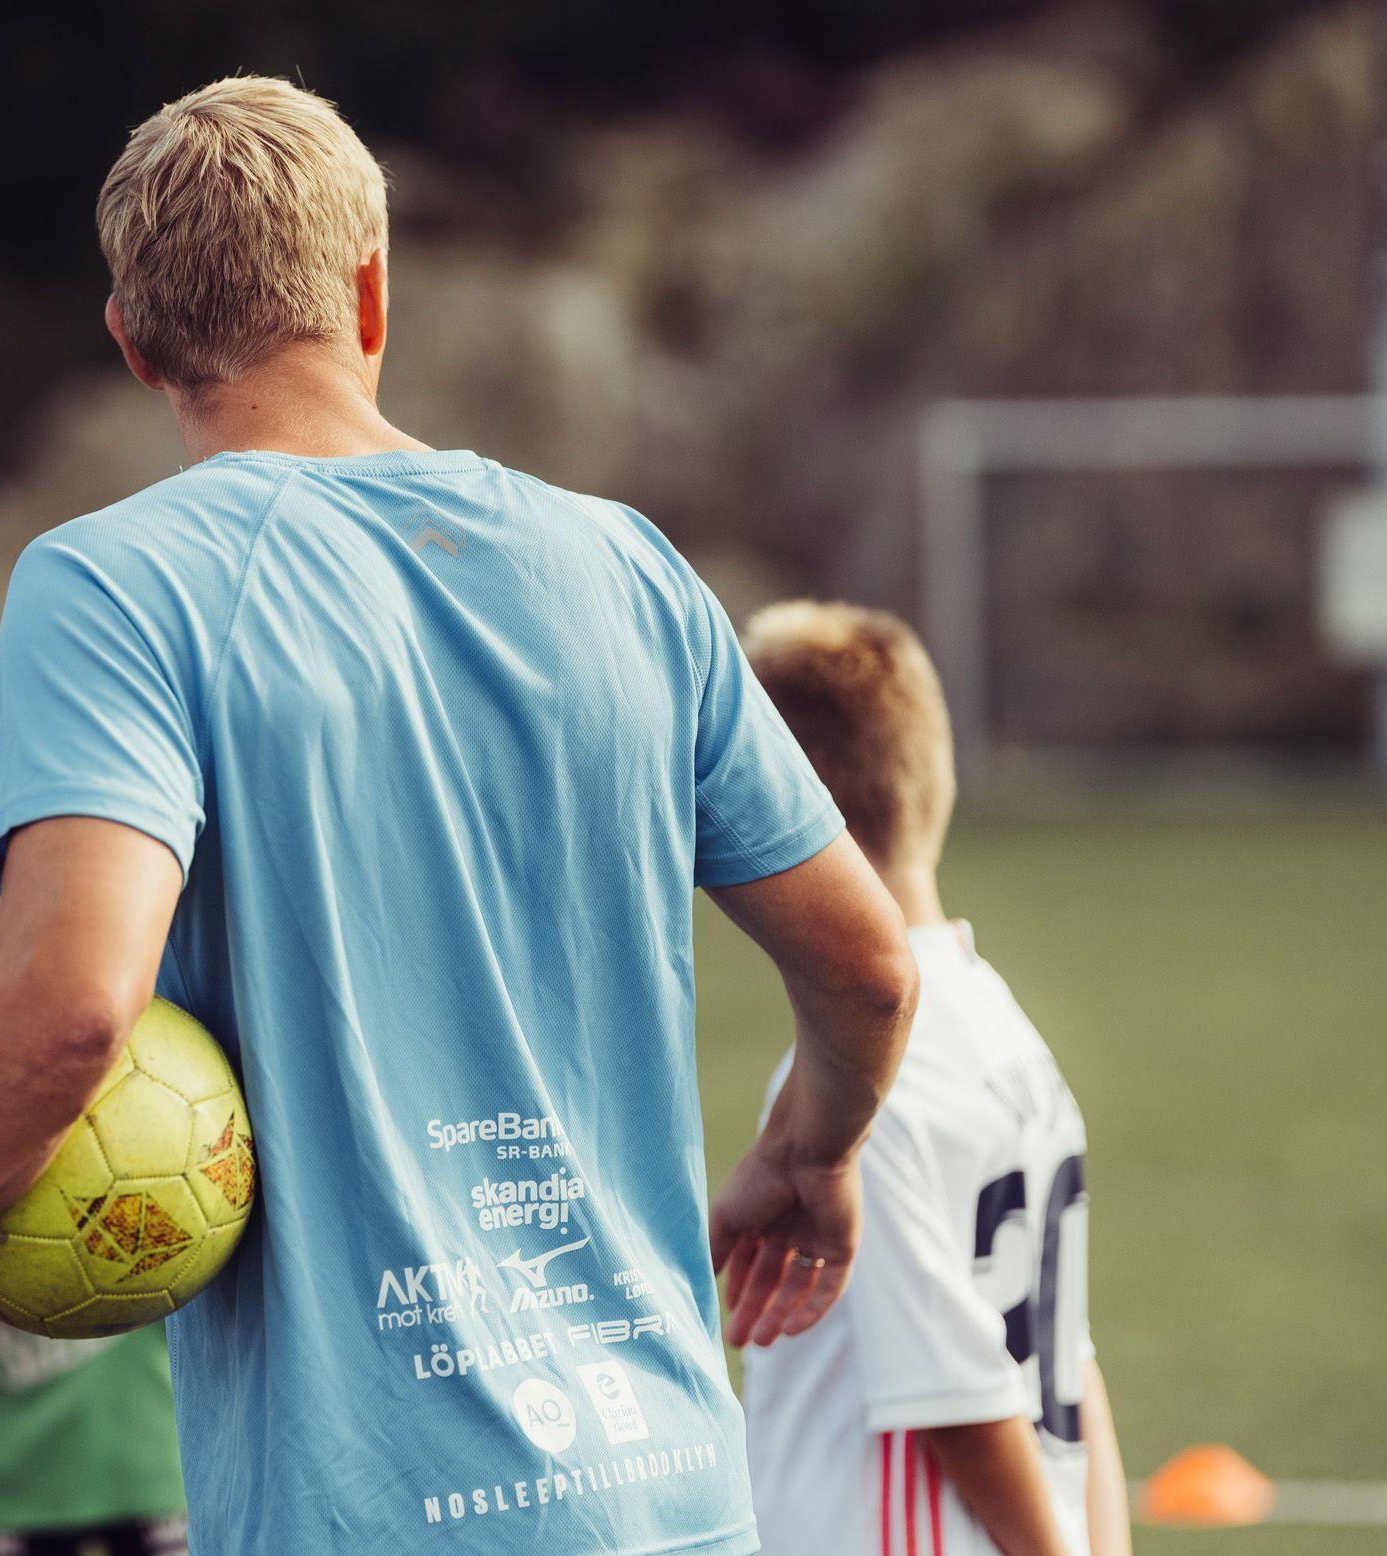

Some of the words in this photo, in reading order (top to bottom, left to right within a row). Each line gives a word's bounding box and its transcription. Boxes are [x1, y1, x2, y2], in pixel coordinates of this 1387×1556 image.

[471, 1167, 585, 1208] skandia
[378, 1305, 422, 1330] mot
[426, 1303, 464, 1325] kre
[414, 1331, 558, 1380] LÖPLABBET
[424, 1443, 716, 1523] NOSLEEPTILLBROOKLYN
